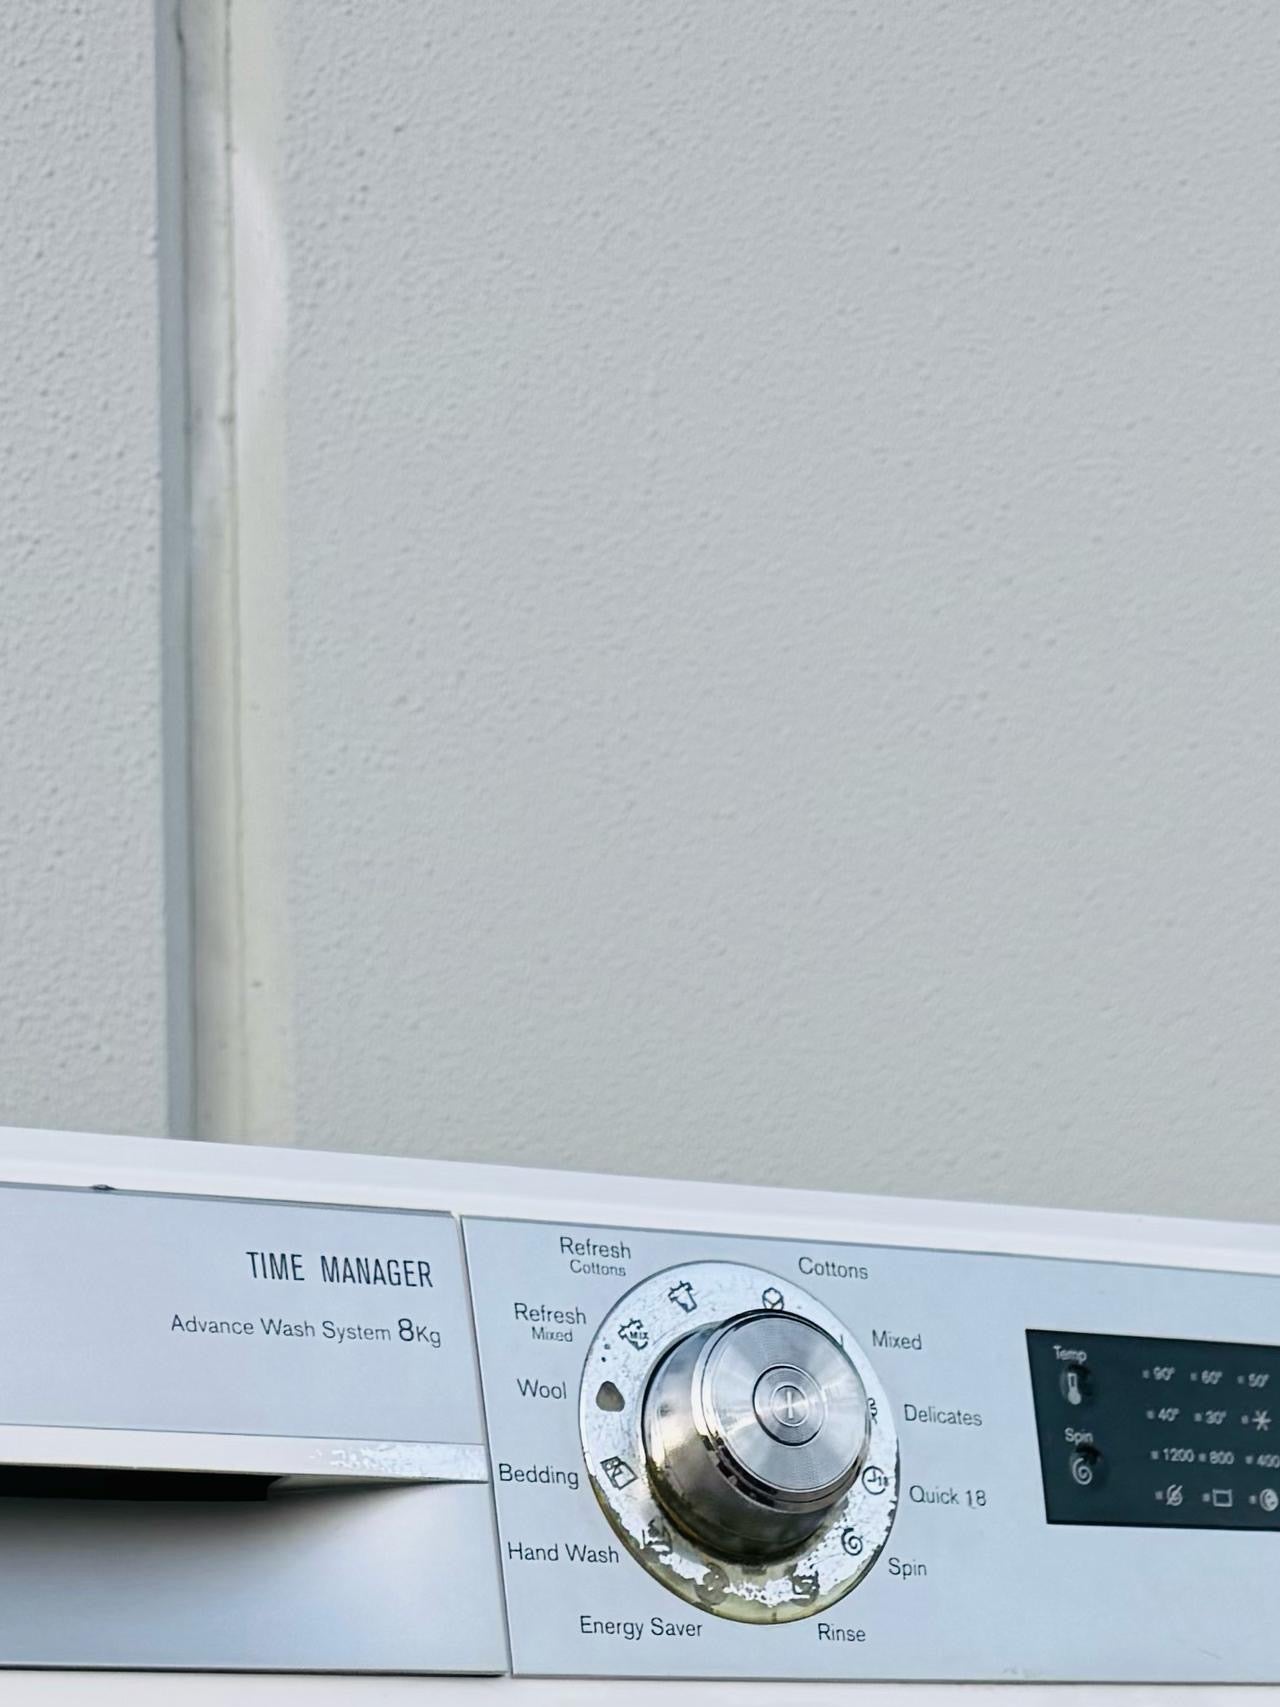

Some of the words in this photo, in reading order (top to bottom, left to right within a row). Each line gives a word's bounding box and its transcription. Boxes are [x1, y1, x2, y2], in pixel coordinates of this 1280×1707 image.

[560, 1237, 631, 1260] Refresh
[246, 1250, 306, 1282] TIME
[320, 1255, 433, 1289] MANAGER
[570, 1259, 627, 1277] Cottons
[798, 1256, 869, 1280] Cottons
[514, 1303, 587, 1325] Refresh
[170, 1314, 254, 1338] Advance
[261, 1317, 315, 1340] Wash
[322, 1320, 392, 1345] System
[398, 1316, 442, 1350] 8Kg
[531, 1326, 574, 1343] Mixed
[872, 1330, 923, 1351] Mixed
[1053, 1345, 1088, 1364] Temp
[517, 1379, 568, 1400] Wool
[903, 1403, 984, 1427] Delicates
[1064, 1427, 1093, 1445] Spin
[498, 1463, 580, 1490] Bedding
[909, 1484, 961, 1505] Quick
[966, 1489, 988, 1509] 18
[507, 1542, 561, 1563] Hand
[564, 1543, 620, 1564] Wash
[888, 1557, 928, 1578] Spin
[580, 1615, 644, 1640] Energy
[650, 1617, 703, 1638] Saver
[818, 1623, 866, 1643] Rinse
